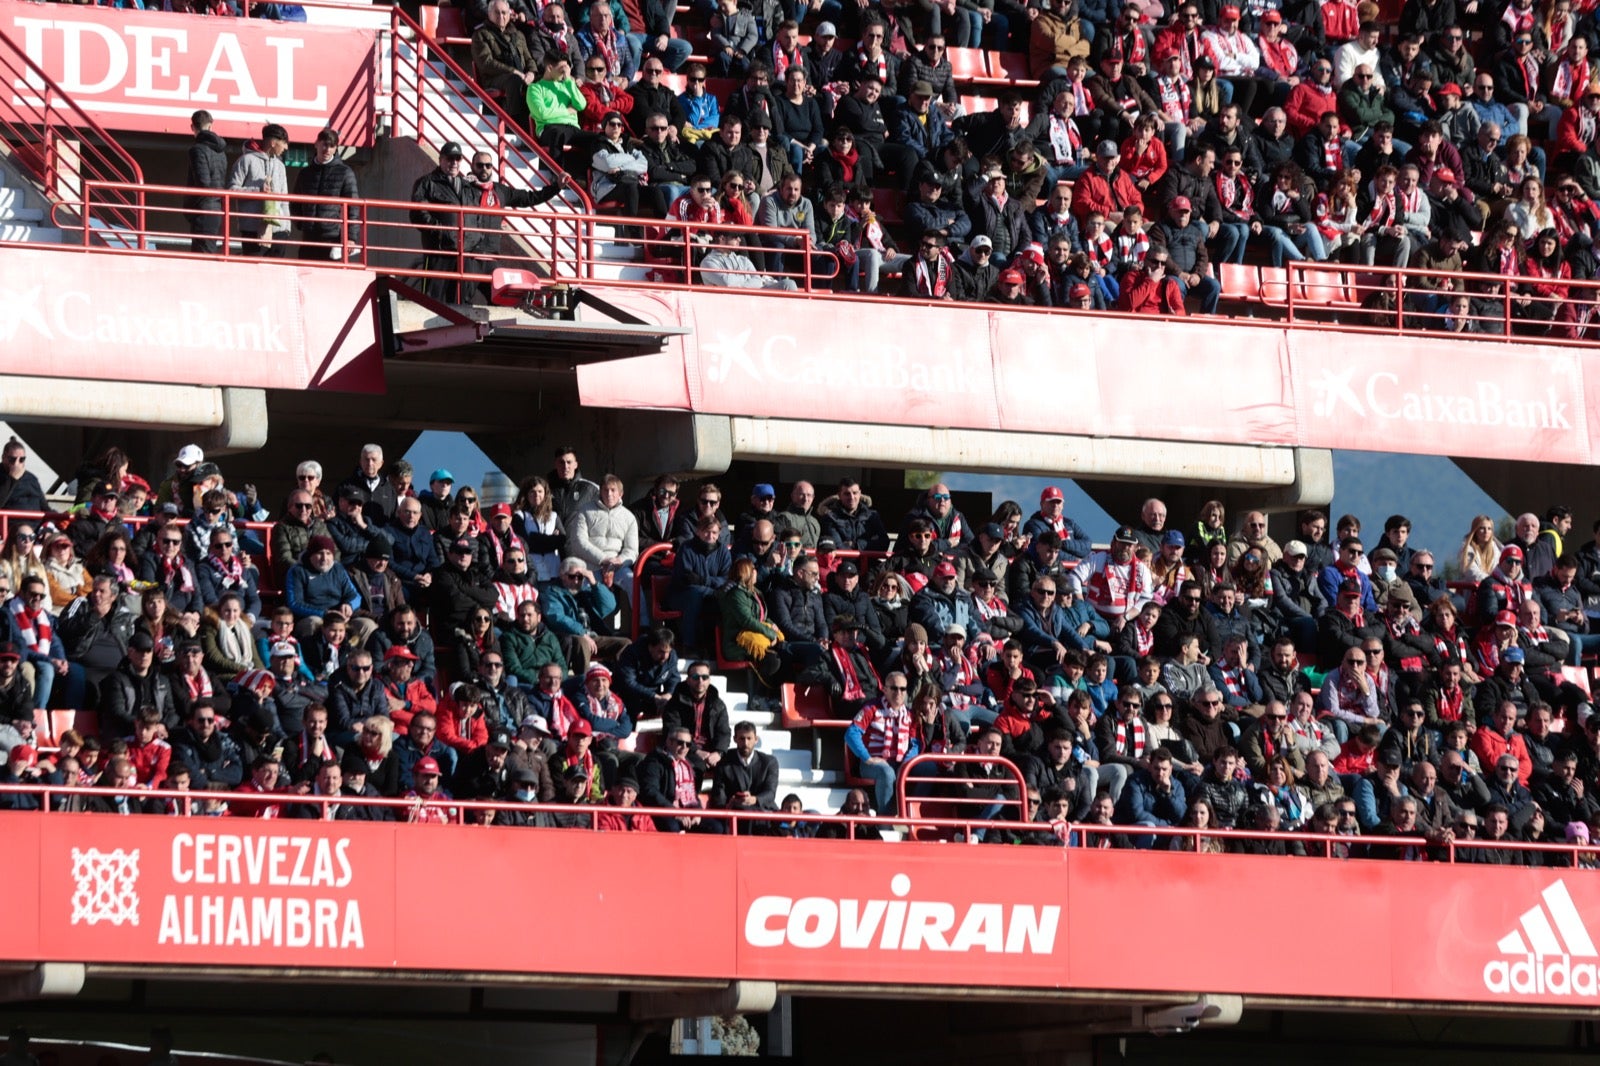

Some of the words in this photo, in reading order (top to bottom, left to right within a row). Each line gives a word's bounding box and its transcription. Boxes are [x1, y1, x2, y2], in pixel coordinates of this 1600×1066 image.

[13, 16, 328, 111] IDEAL
[54, 291, 289, 354] CaixaBank
[761, 335, 977, 393] CaixaBank
[1366, 371, 1573, 430] CaixaBank
[171, 832, 353, 888] CERVEZAS
[158, 894, 365, 949] ALHAMBRA
[1483, 952, 1600, 996] adida
